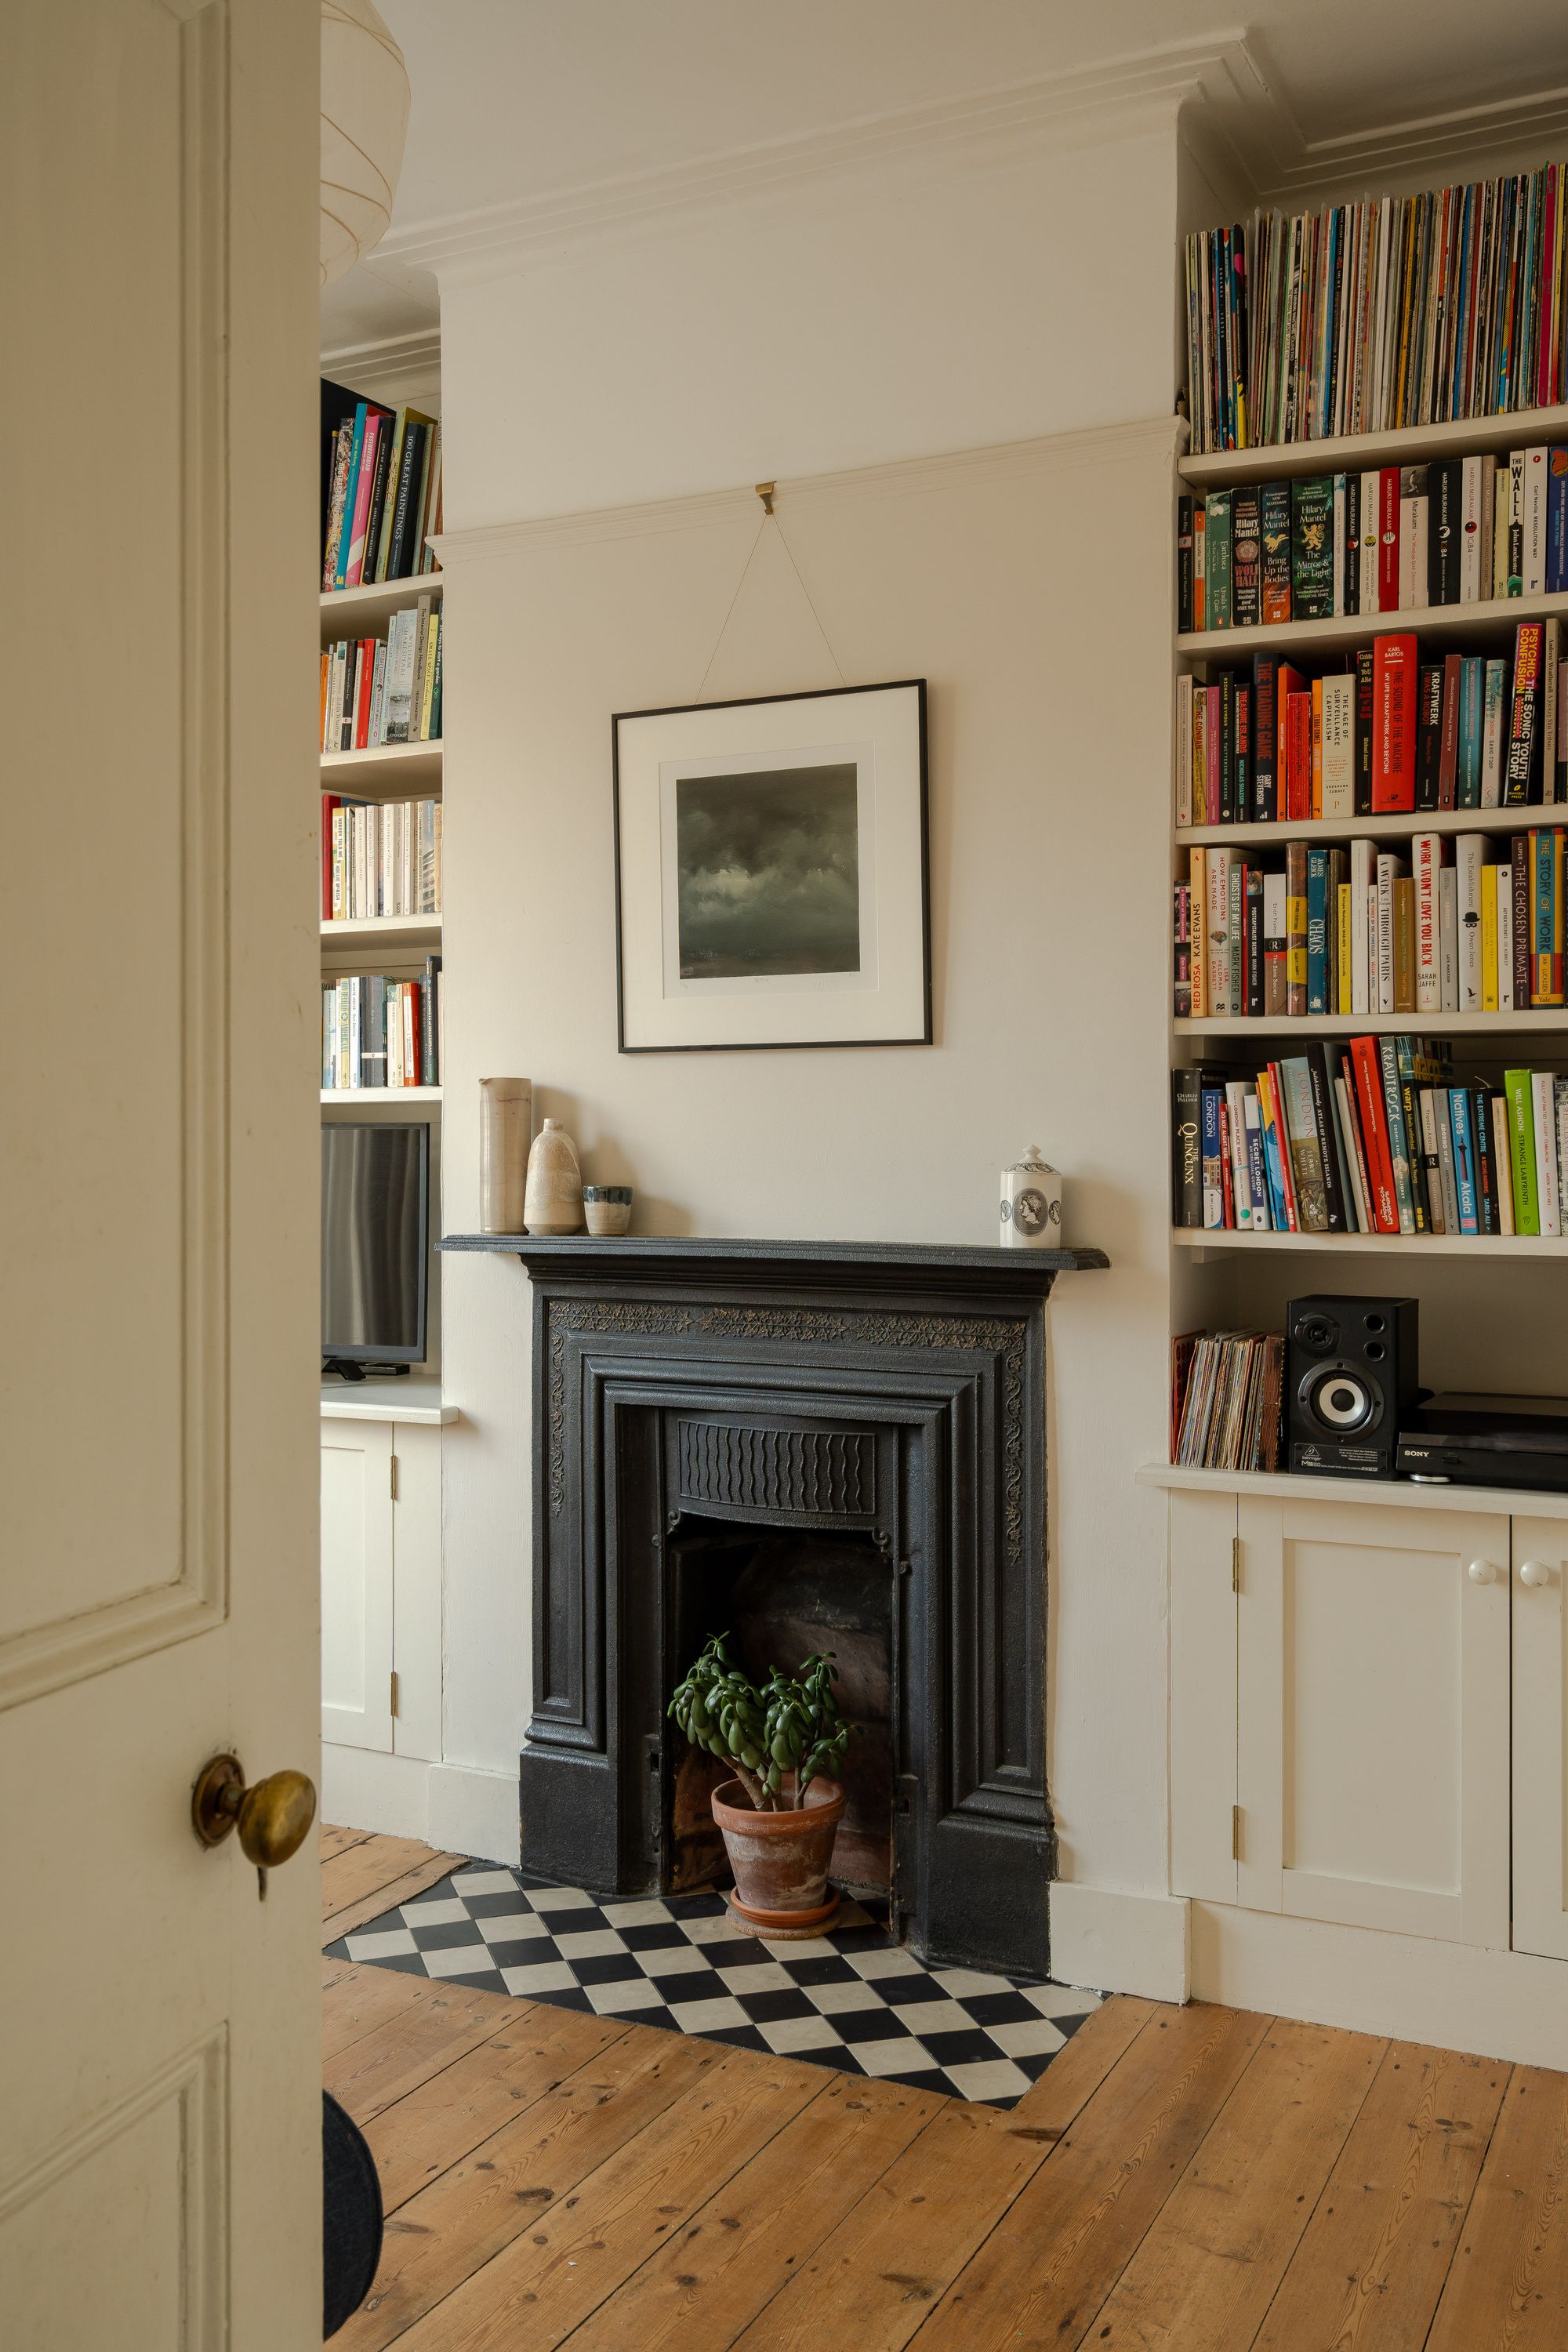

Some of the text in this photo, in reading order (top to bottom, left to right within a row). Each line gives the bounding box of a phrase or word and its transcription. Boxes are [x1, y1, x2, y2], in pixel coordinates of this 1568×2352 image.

[401, 451, 412, 485] GREAT
[1512, 466, 1523, 517] WALL
[394, 486, 408, 540] PAINTINGS
[1236, 518, 1259, 528] Hilary
[1263, 520, 1290, 530] Mantel
[1265, 510, 1288, 521] Hilary
[1299, 513, 1327, 524] Mantel
[1301, 506, 1324, 515] Hilary
[1235, 526, 1260, 539] Mantel
[1220, 540, 1229, 570] Earthsea
[1234, 564, 1259, 576] WOLF
[1264, 565, 1290, 575] Up the
[1267, 557, 1287, 567] Bring
[1297, 567, 1330, 579] the Light
[1305, 550, 1320, 560] The
[325, 572, 335, 585] RA
[336, 572, 344, 586] RA
[1236, 575, 1259, 587] HALL
[1265, 573, 1290, 583] Bodies
[400, 626, 408, 677] SHAKESPEARE
[425, 641, 434, 677] SMALL-SPACE
[1515, 628, 1530, 687] CONFUSION
[1526, 627, 1539, 677] PSYCHIC
[1257, 662, 1272, 760] THE TRADING GAME
[1429, 671, 1441, 725] KRAFTWERK
[1392, 671, 1403, 773] THE SOUND OF THE MACHINE
[1518, 679, 1535, 779] THE SONIC YOUTH
[1508, 742, 1520, 779] STORY
[1256, 775, 1265, 804] STEVENSON
[1263, 775, 1272, 788] GARY
[1231, 873, 1240, 940] GHOSTS OF MY LIFE
[1420, 839, 1433, 966] WORK WON'T LOVE YOU BACK
[1539, 838, 1551, 952] THE STORY OF WORK
[1192, 903, 1201, 957] KATE EVANS
[1308, 919, 1323, 954] CHAOS
[1515, 865, 1526, 985] THE CHOSEN PRIMATE
[1380, 907, 1390, 982] THROUGH PARIS
[1192, 964, 1201, 1009] RED ROSA
[1231, 946, 1240, 993] MARK FISHER
[1382, 1045, 1400, 1122] KRAUTROCK
[1403, 1087, 1413, 1112] warp
[1297, 1072, 1313, 1138] LONDON
[1452, 1094, 1465, 1134] Natives
[1516, 1106, 1525, 1131] ASHON
[1178, 1122, 1198, 1184] QUINCUNX
[1479, 1132, 1487, 1153] CENTRE
[1356, 1151, 1371, 1208] CHARLIE BROOKER
[1518, 1134, 1530, 1206] STRANGE LABYRINTH
[1460, 1181, 1473, 1214] Akala
